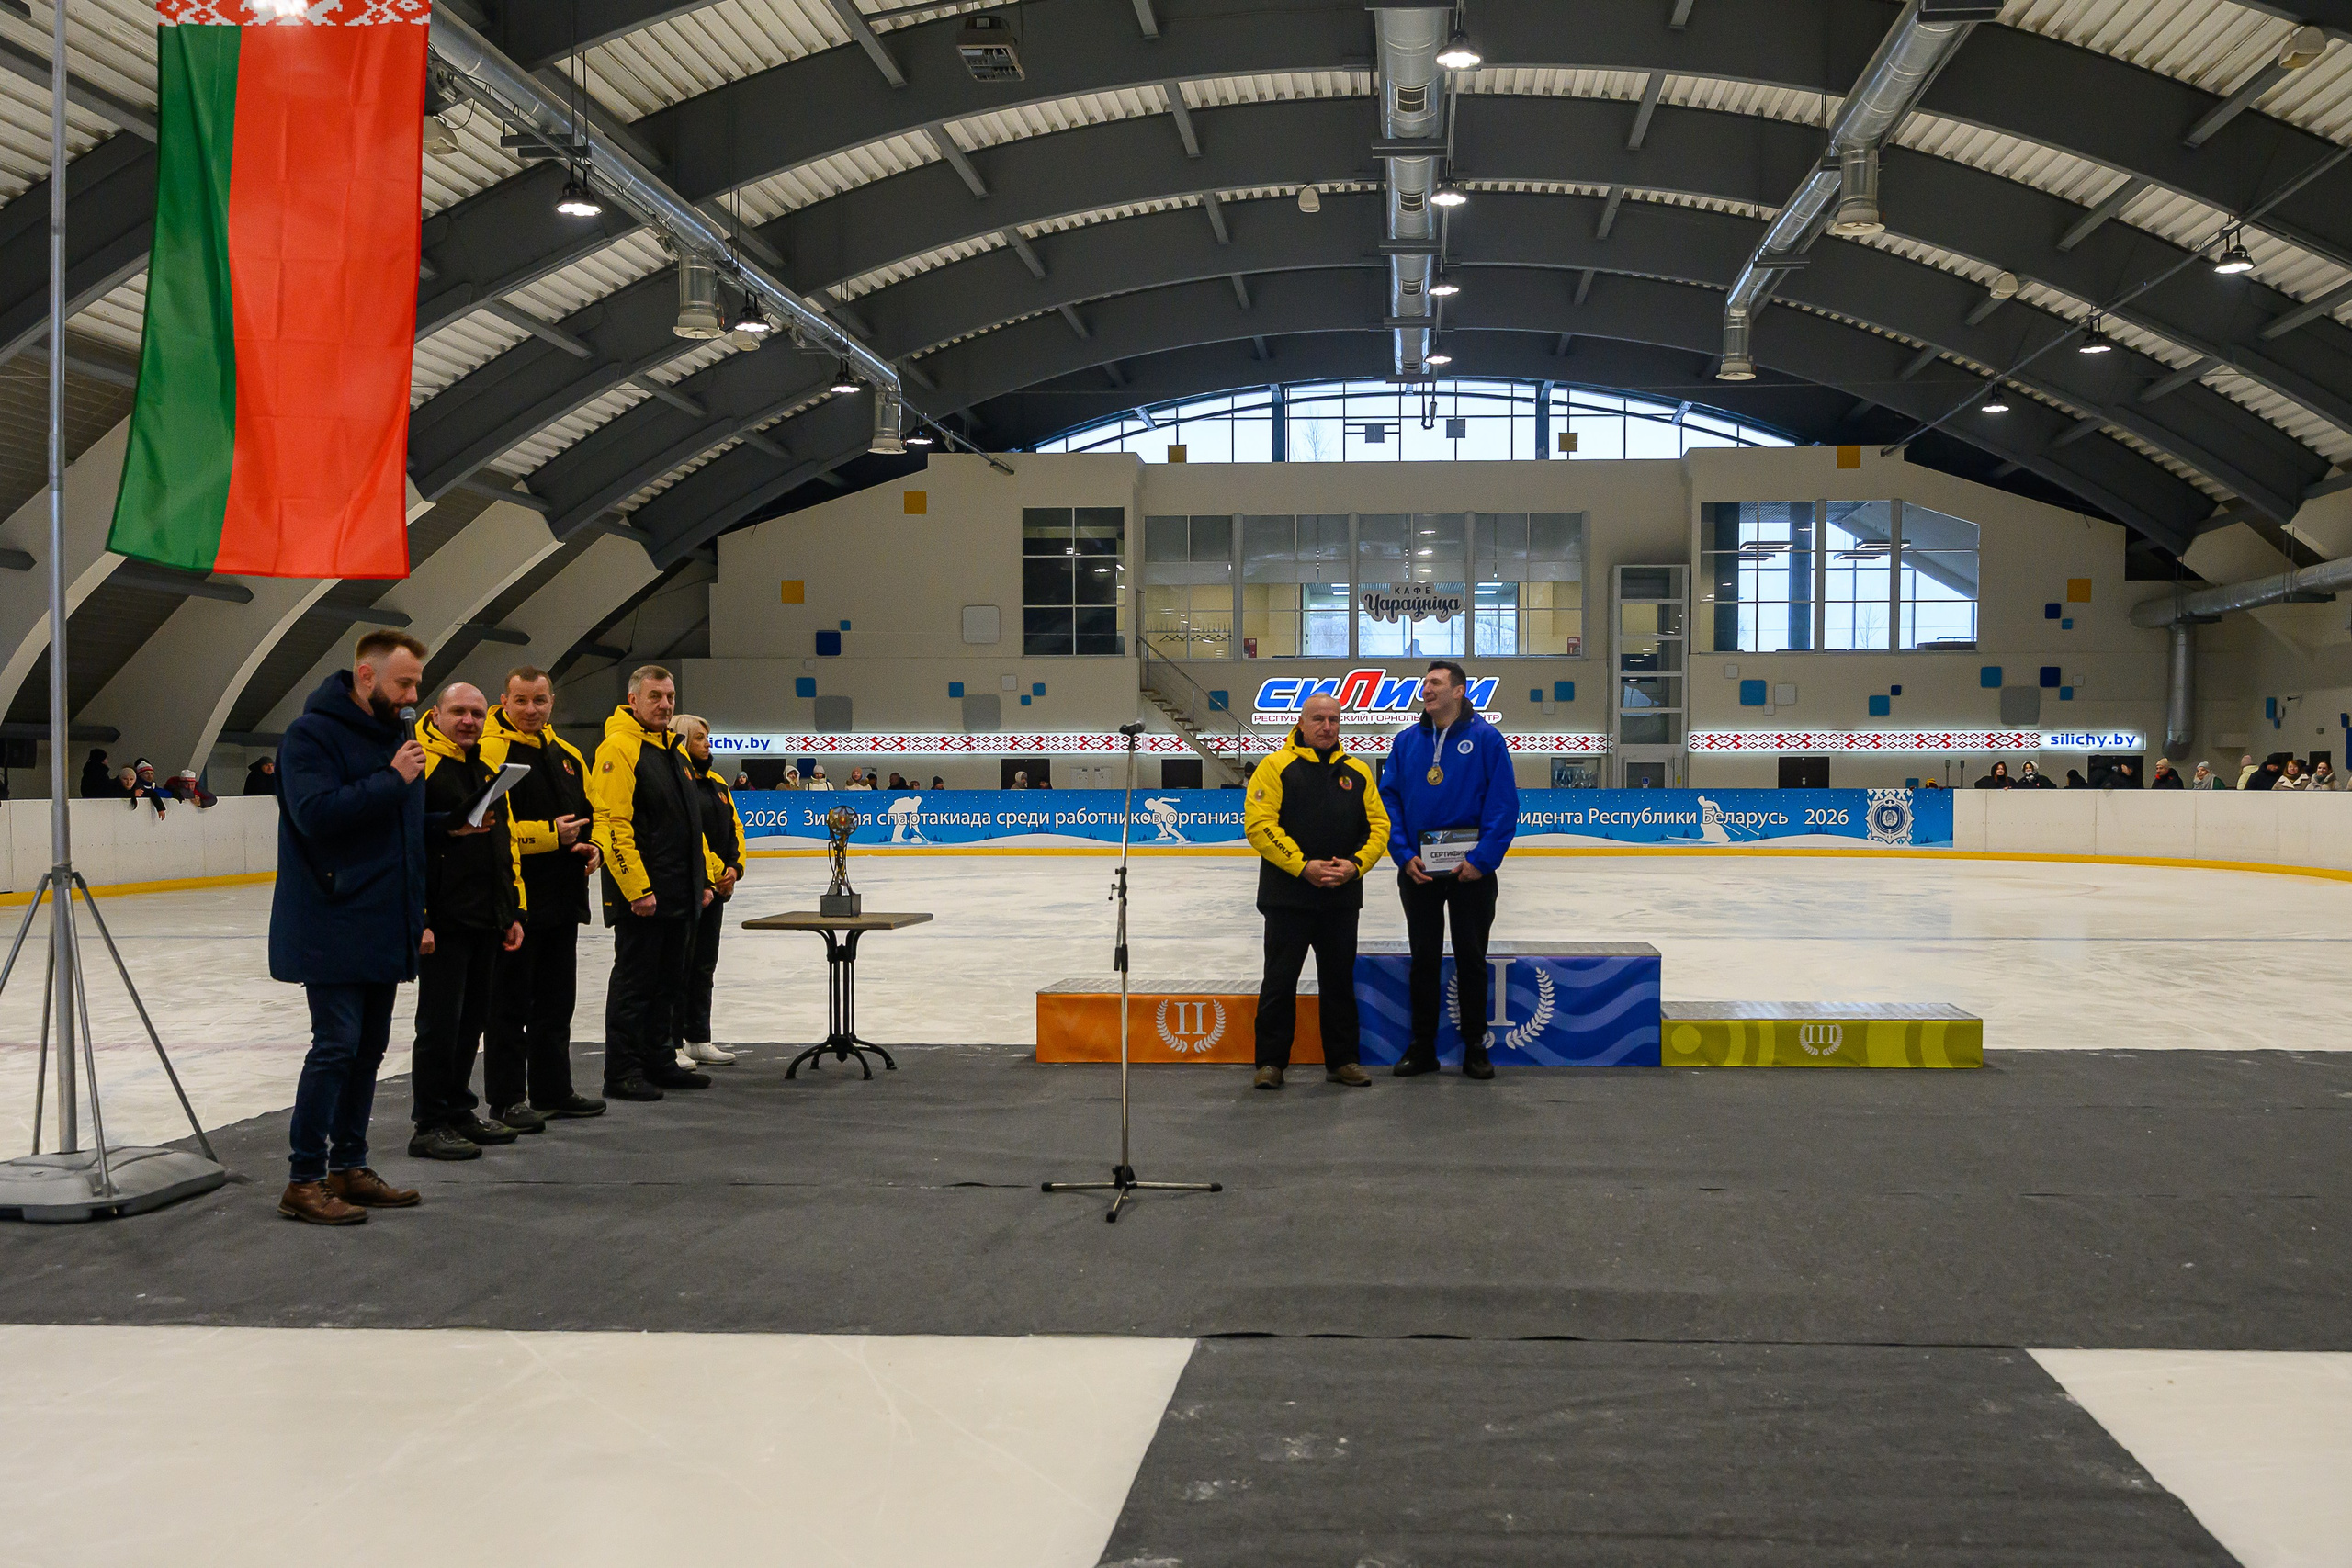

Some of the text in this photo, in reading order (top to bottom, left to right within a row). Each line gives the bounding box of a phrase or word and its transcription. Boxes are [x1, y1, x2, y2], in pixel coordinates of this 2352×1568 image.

[1395, 586, 1430, 595] КАФЕ
[1364, 594, 1462, 618] Чараўніца
[1254, 671, 1498, 711] СИЛИИ
[1254, 713, 1368, 722] РЕСПУБСКИЙ
[709, 737, 770, 750] ichy.by
[2050, 733, 2136, 747] silichy.by
[744, 810, 788, 827] 2026
[876, 812, 991, 828] спартакиада
[996, 812, 1050, 828] среди
[1055, 807, 1161, 829] работников
[1165, 812, 1245, 829] организа
[1589, 807, 1696, 828] Республики
[1702, 807, 1789, 829] Беларусь
[1804, 808, 1849, 825] 2026
[1262, 827, 1293, 859] BELARUS
[1174, 1002, 1206, 1034] II
[1807, 1024, 1838, 1044] III
